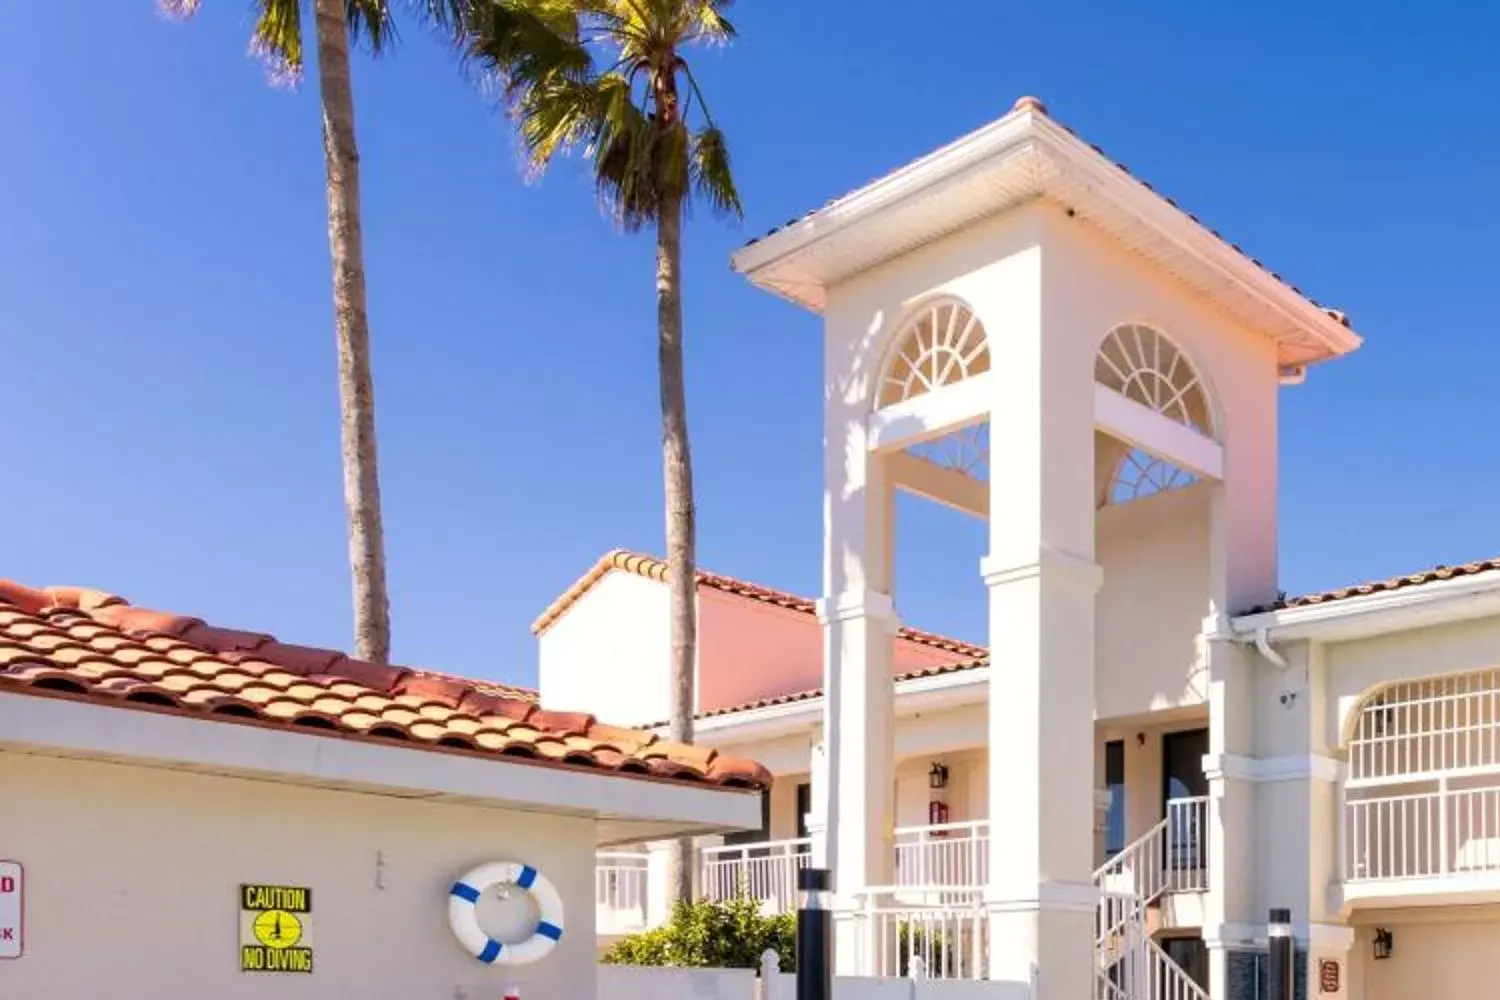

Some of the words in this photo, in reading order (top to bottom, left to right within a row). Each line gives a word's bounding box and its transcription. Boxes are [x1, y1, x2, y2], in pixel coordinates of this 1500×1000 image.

[246, 887, 305, 910] CAUTION
[243, 947, 264, 969] NO
[267, 948, 311, 970] DIVING
